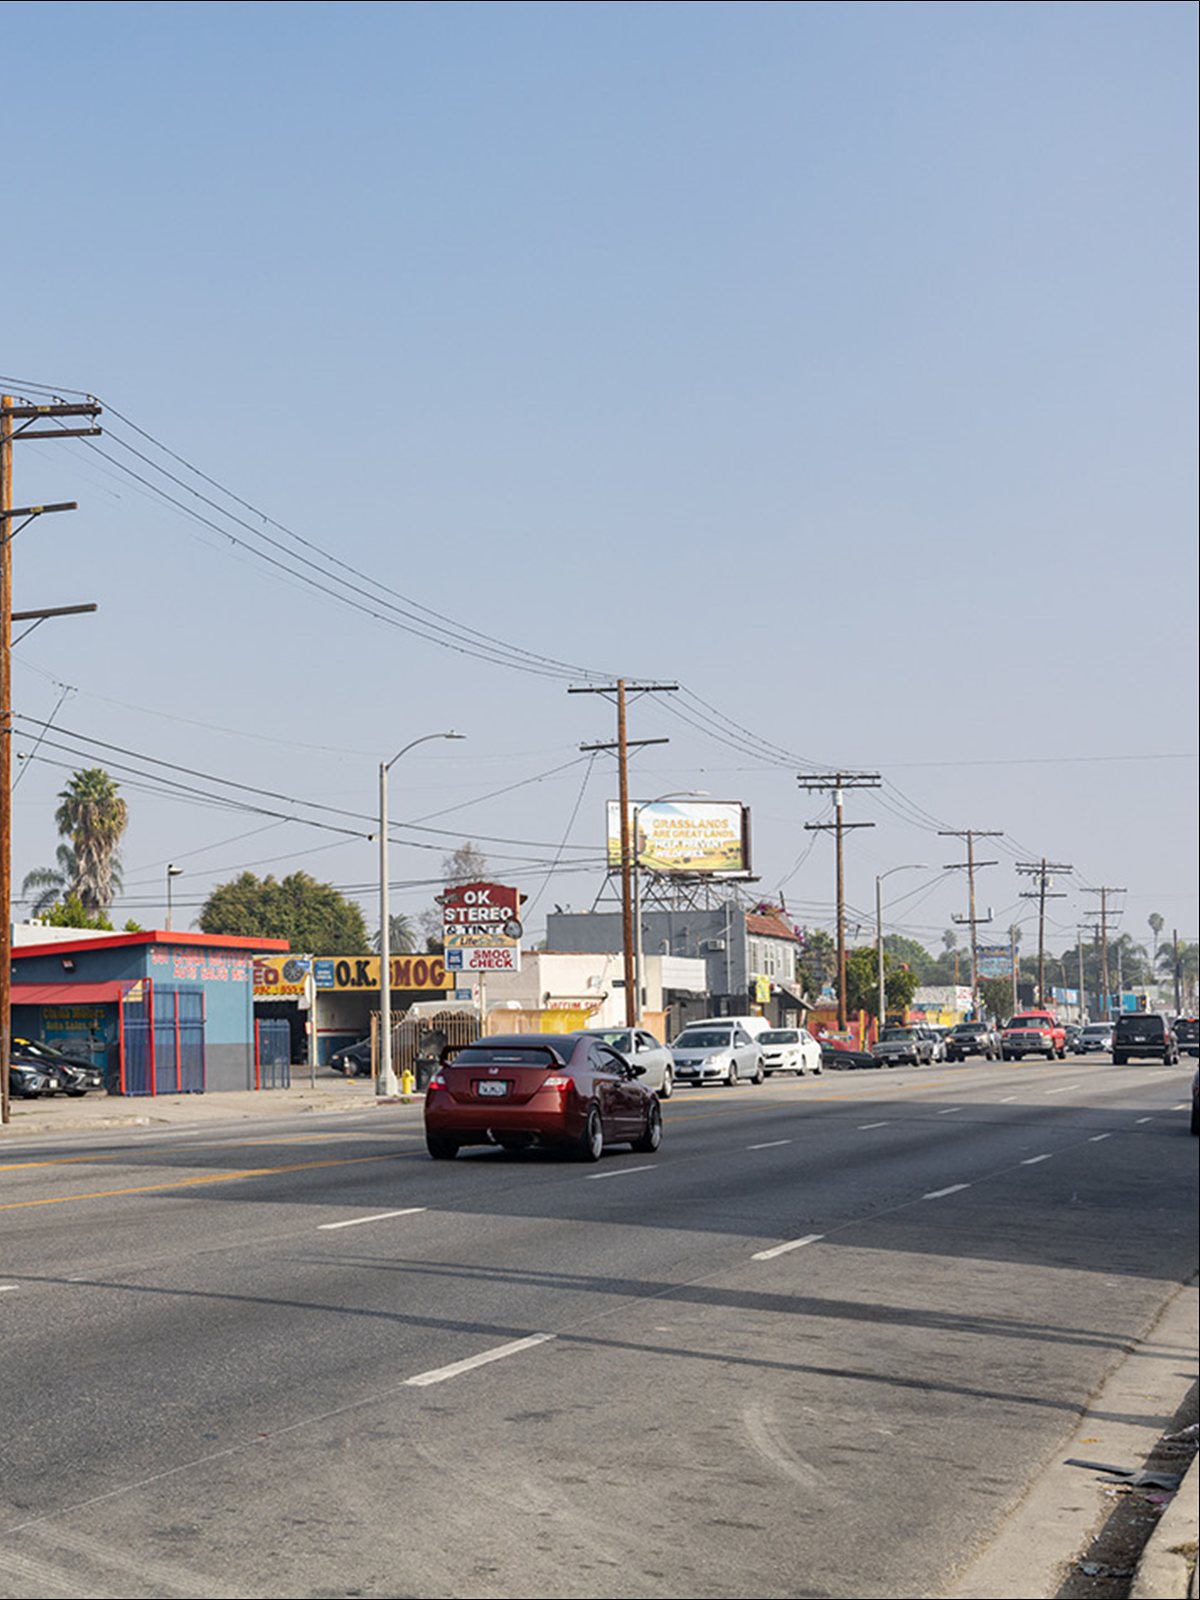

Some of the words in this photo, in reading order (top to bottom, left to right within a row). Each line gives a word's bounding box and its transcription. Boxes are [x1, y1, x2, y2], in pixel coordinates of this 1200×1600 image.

[652, 819, 729, 829] GRASSLANDS
[652, 830, 670, 838] ARE
[672, 830, 702, 838] GREAT
[463, 889, 491, 905] OK
[444, 906, 514, 923] STEREO
[463, 925, 500, 935] TINT
[173, 947, 206, 966] CHINA
[209, 950, 253, 968] MOTORS
[473, 949, 511, 959] SMOG
[469, 958, 514, 968] CHECK
[173, 966, 197, 979] AUTO
[200, 966, 229, 981] SALES
[336, 960, 377, 987] O.K.
